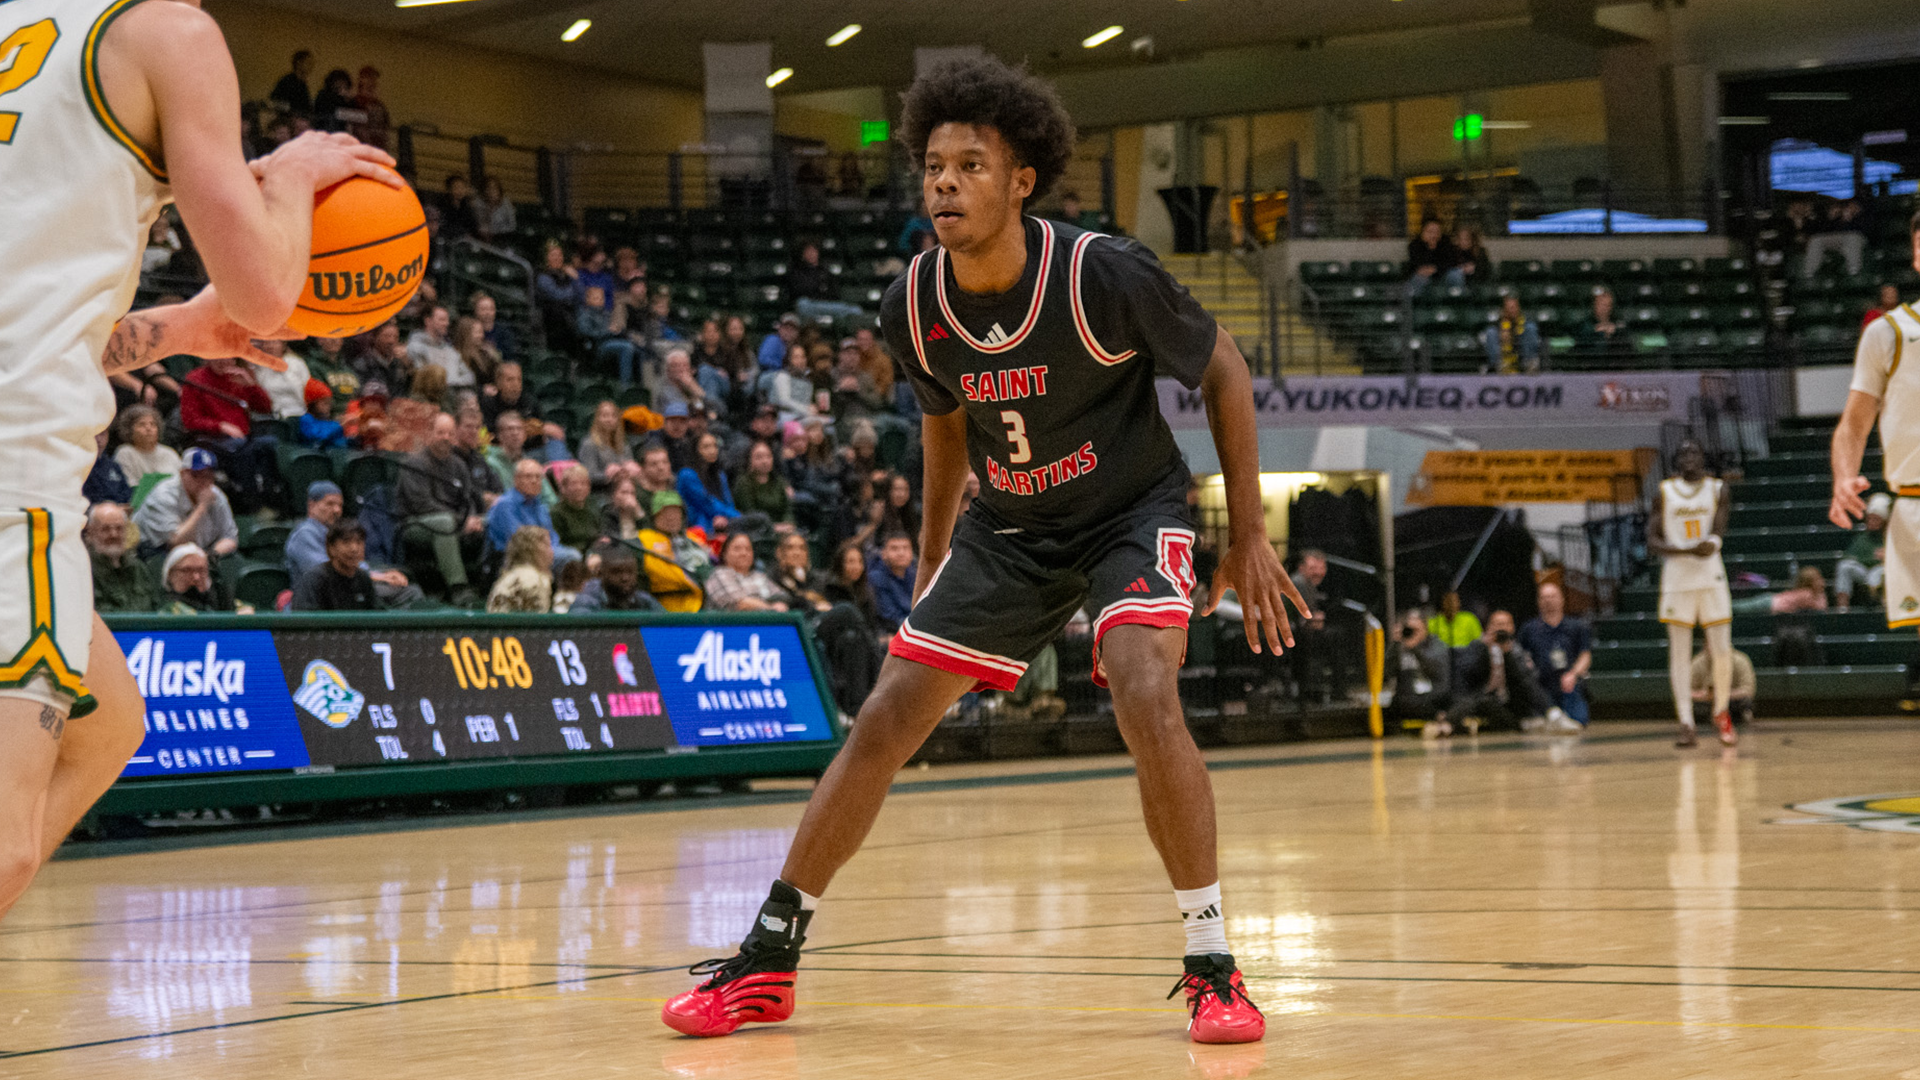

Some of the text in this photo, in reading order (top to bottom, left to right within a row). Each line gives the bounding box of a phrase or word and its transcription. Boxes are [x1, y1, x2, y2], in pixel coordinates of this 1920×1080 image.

[309, 253, 423, 301] Wilson
[961, 365, 1048, 402] SAINT
[1000, 410, 1032, 464] 3
[987, 440, 1098, 495] MARTINS
[1684, 519, 1701, 539] 11
[127, 638, 245, 703] Alaska
[371, 643, 395, 690] 7
[442, 637, 533, 690] 10:48
[548, 639, 588, 686] 13
[678, 630, 782, 686] Alaska
[419, 697, 436, 725] 0
[590, 692, 604, 718] 1
[607, 692, 662, 717] SAINTS
[697, 688, 788, 710] AIRLINES
[143, 707, 250, 733] IRLINES
[465, 712, 520, 743] PER 1
[724, 721, 785, 740] CENTER
[375, 729, 447, 760] TOL 4
[560, 723, 615, 750] TOL 4
[157, 746, 242, 768] CENTER
